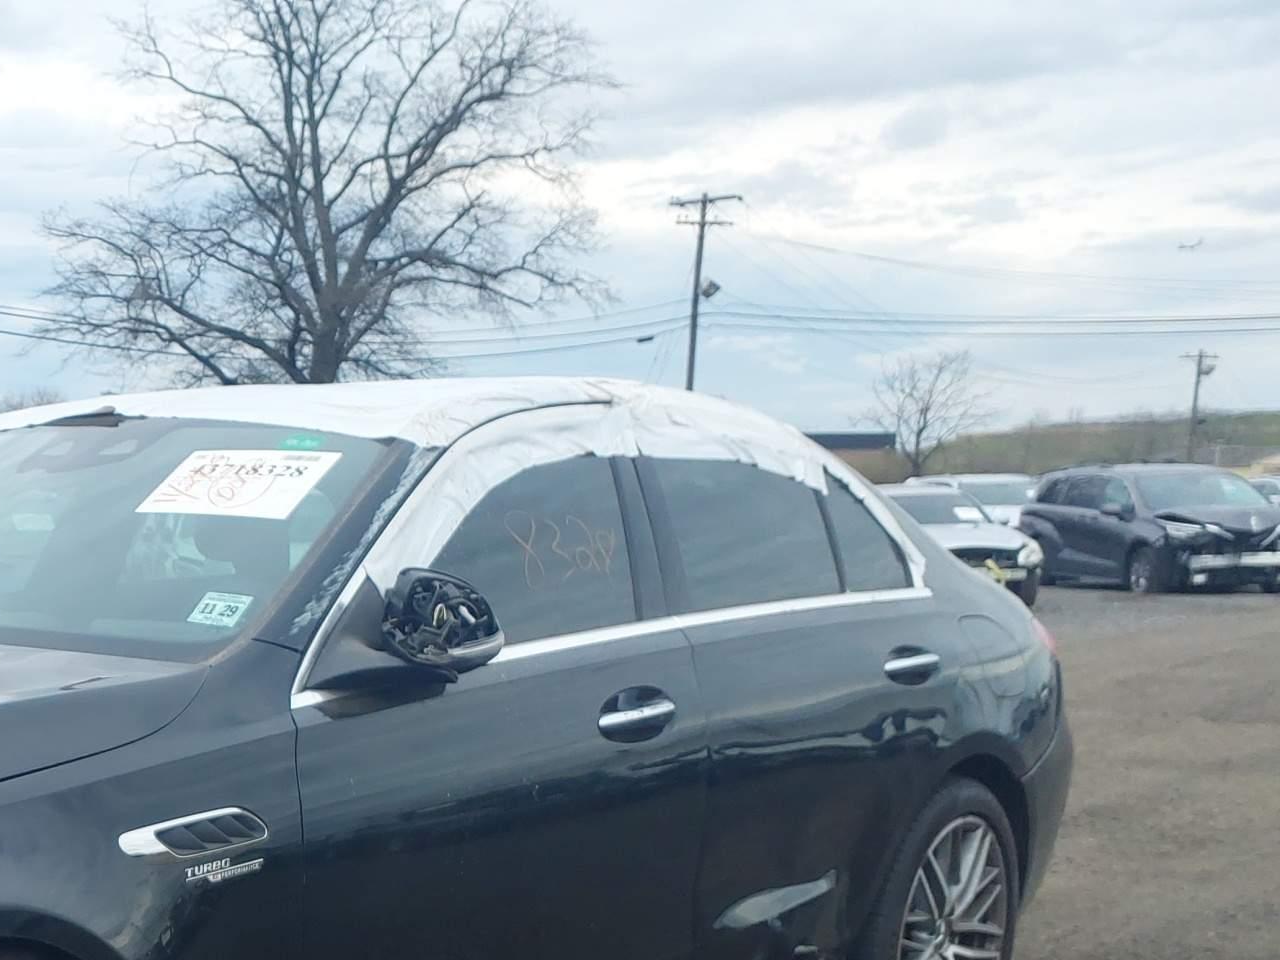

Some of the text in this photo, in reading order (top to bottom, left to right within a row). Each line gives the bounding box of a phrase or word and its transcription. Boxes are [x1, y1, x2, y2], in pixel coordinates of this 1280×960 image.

[192, 462, 309, 478] 43718328
[200, 603, 240, 617] 11 29
[185, 857, 231, 878] TURBO
